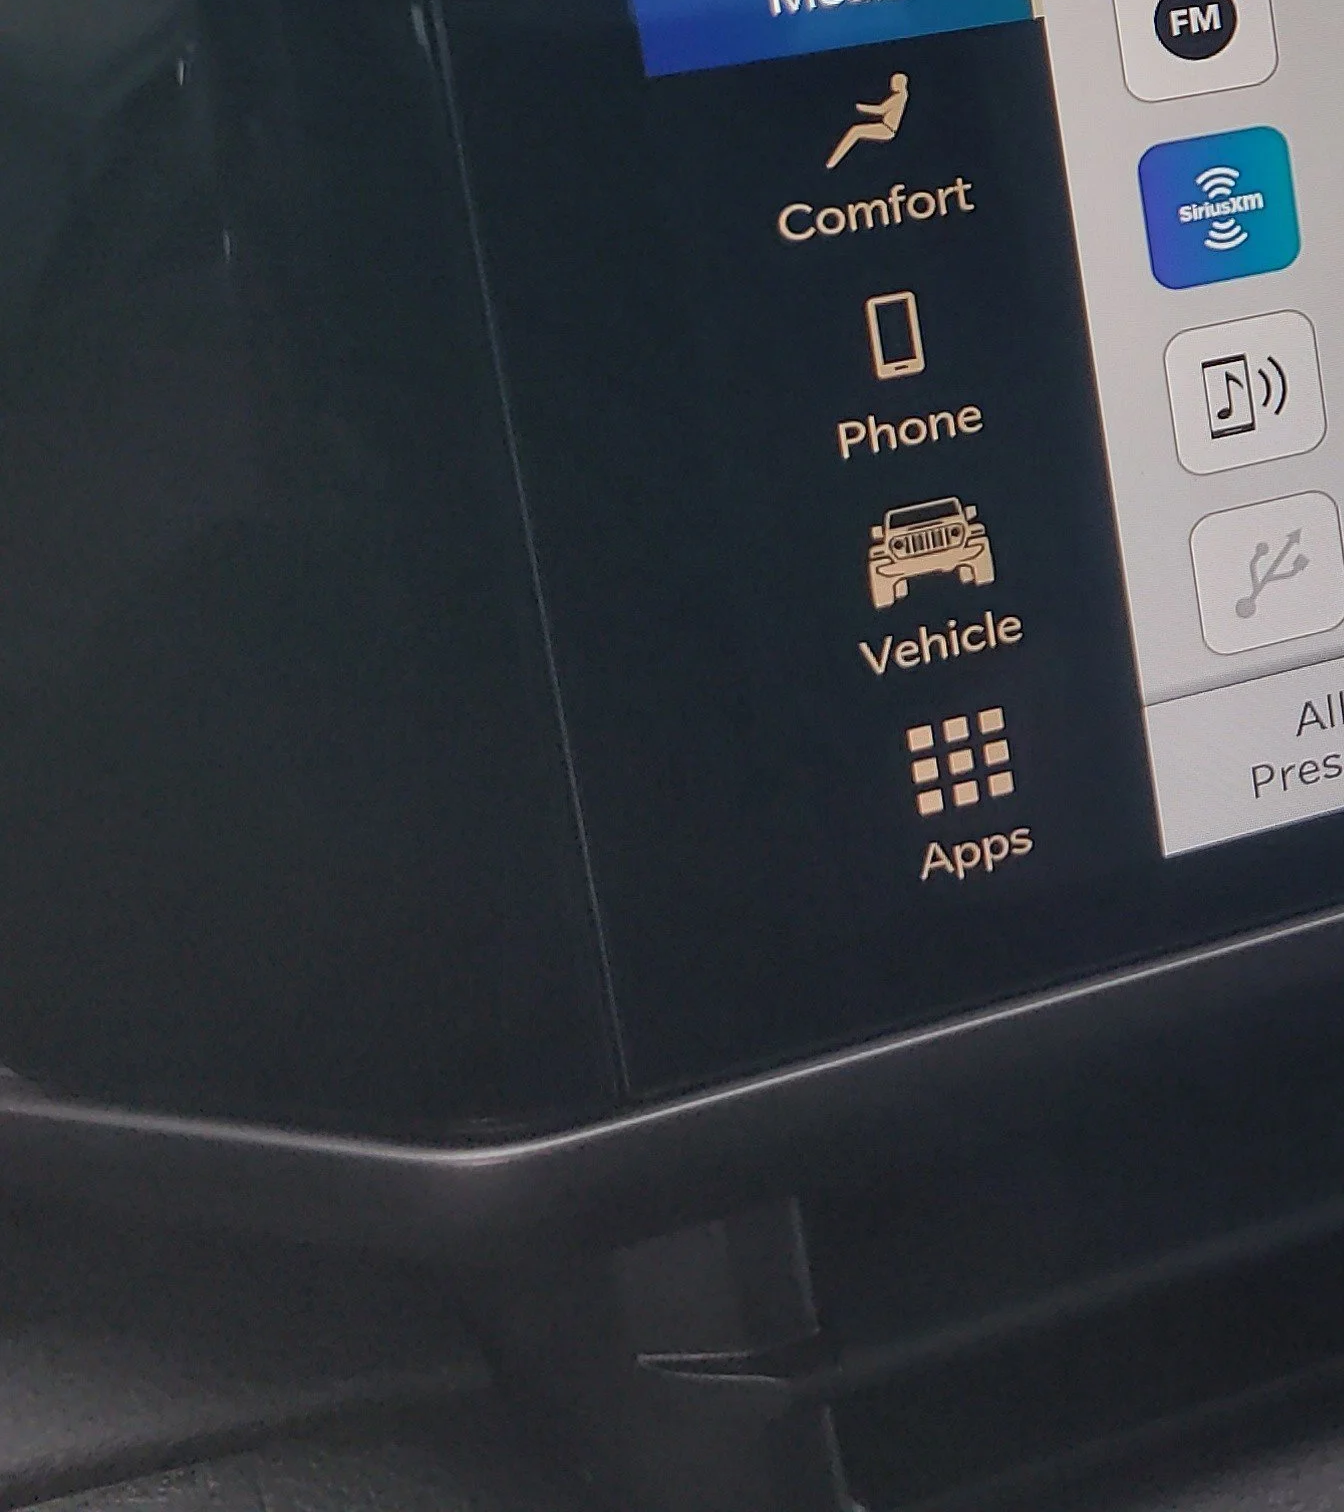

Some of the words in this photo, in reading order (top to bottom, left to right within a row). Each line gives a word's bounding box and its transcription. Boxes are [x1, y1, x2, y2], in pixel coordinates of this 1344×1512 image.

[1169, 5, 1221, 36] FM
[778, 178, 974, 241] Comfort
[836, 403, 984, 458] Phone
[859, 611, 1023, 675] Vehicle
[920, 824, 1033, 881] Apps
